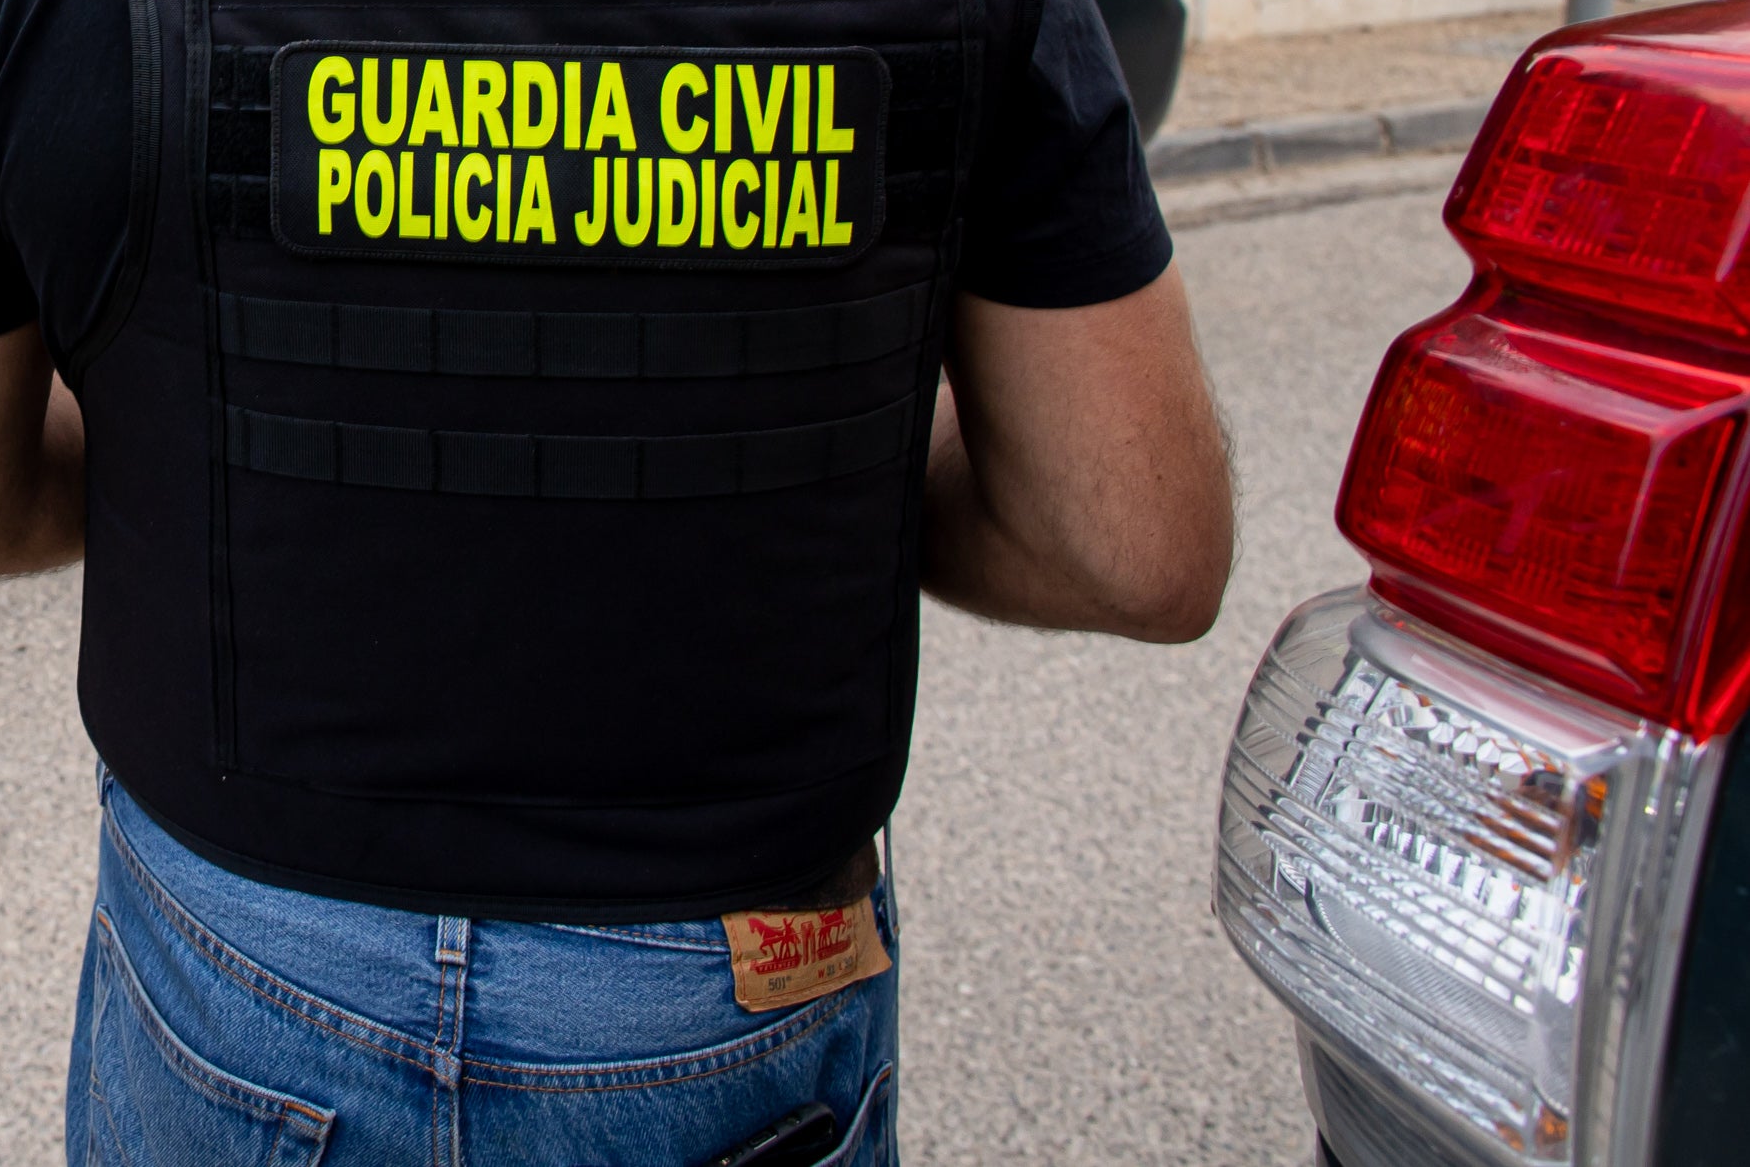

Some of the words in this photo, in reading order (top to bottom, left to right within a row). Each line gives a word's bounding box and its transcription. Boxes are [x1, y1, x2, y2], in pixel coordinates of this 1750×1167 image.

[307, 55, 637, 152] GUARDIA
[660, 62, 855, 154] CIVIL
[318, 148, 557, 244] POLICIA
[574, 156, 853, 249] JUDICIAL
